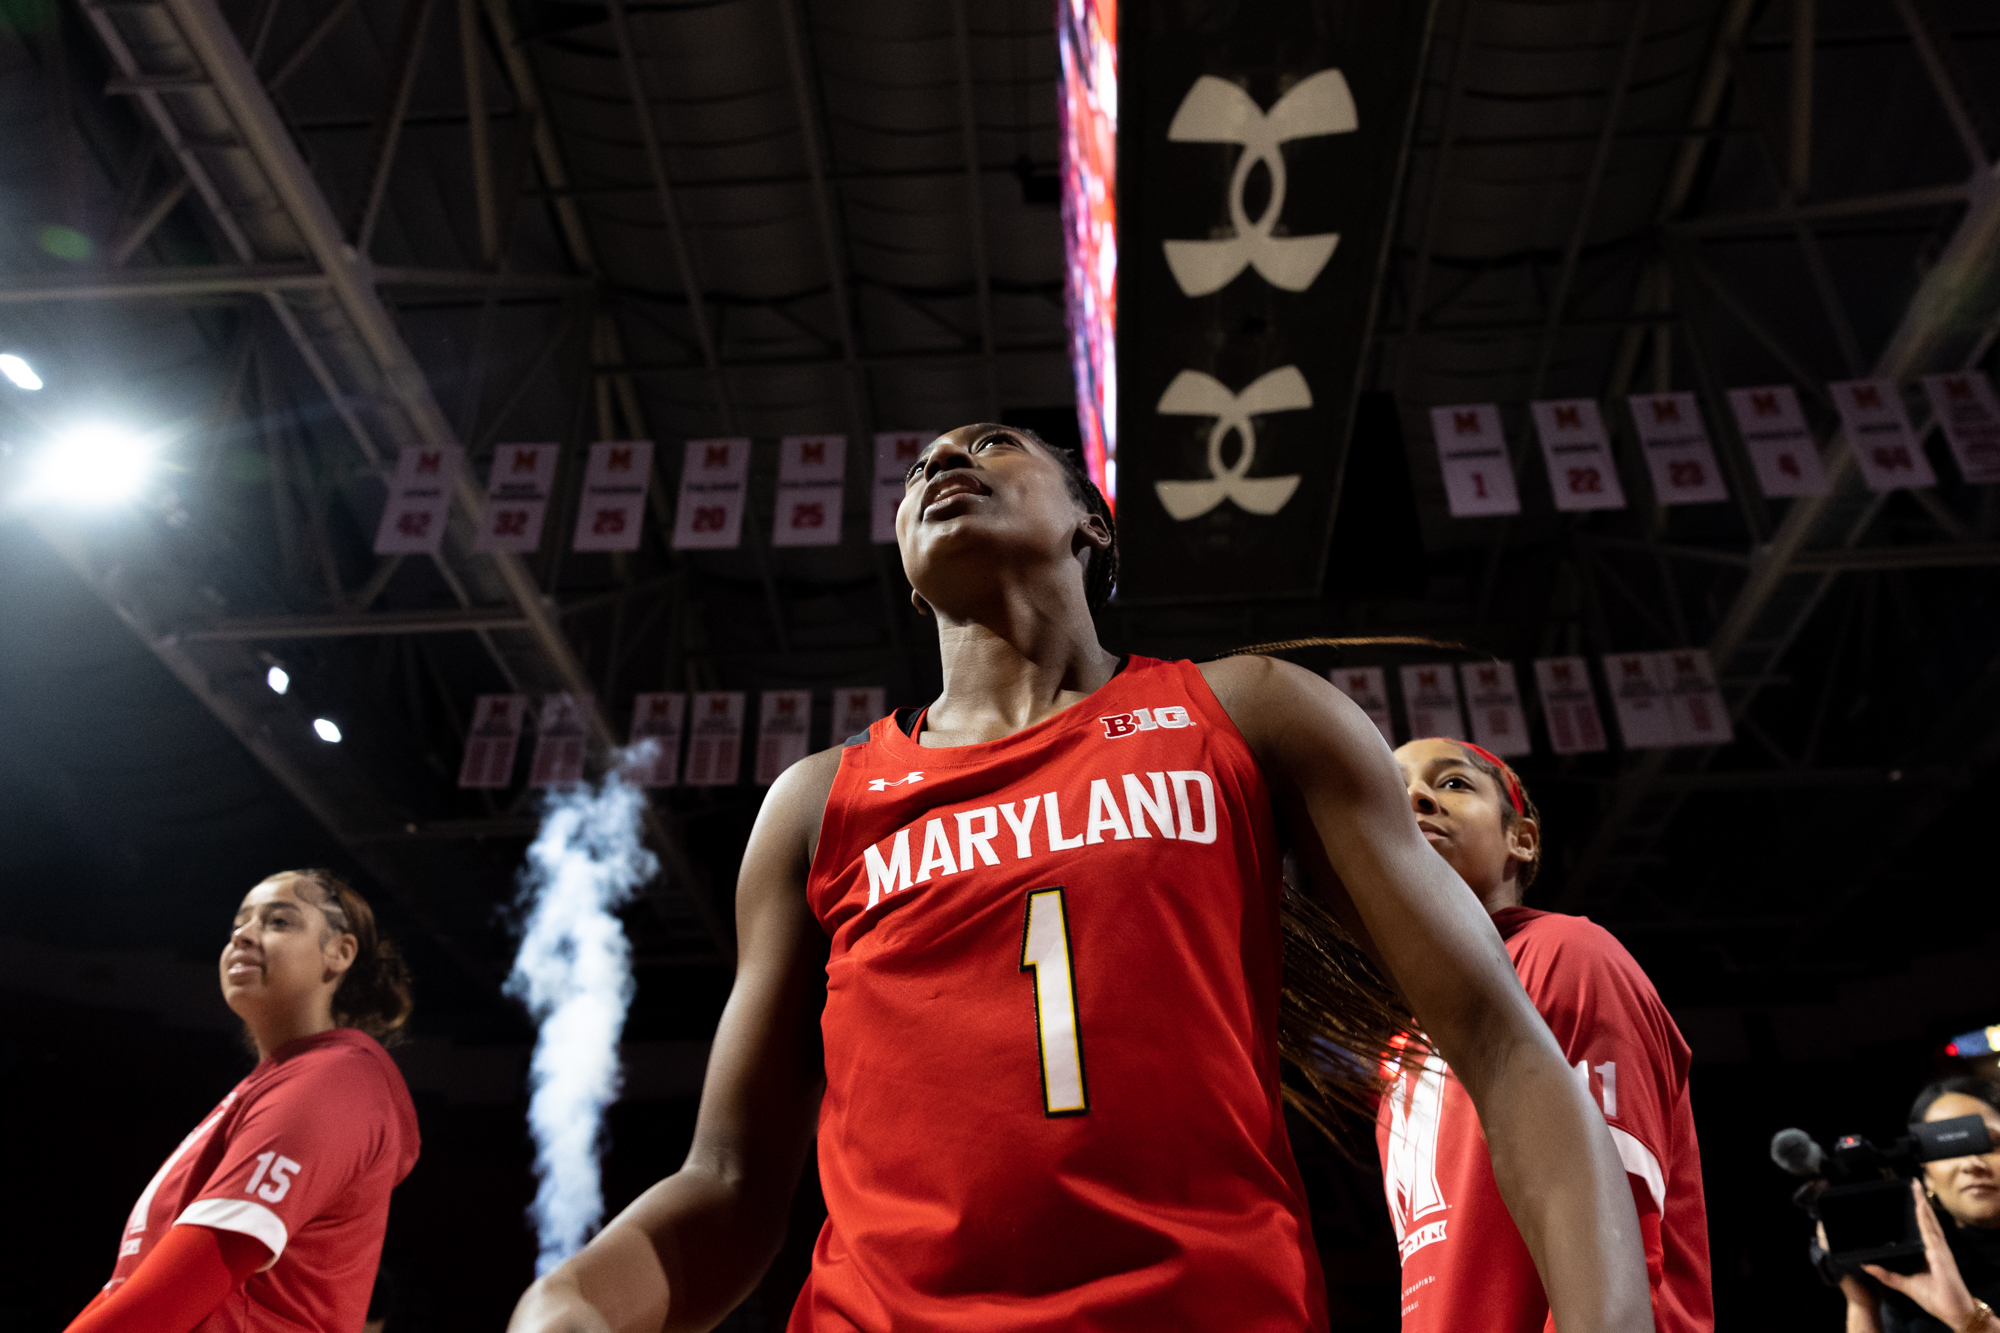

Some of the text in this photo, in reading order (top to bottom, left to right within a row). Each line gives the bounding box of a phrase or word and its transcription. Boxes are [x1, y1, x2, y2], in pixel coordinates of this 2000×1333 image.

[513, 450, 537, 473] M
[608, 449, 631, 471] M
[704, 445, 729, 467] M
[801, 442, 825, 464] M
[1471, 472, 1487, 498] 1
[1567, 466, 1601, 493] 22
[593, 508, 627, 534] 25
[692, 506, 727, 532] 20
[792, 502, 825, 529] 25
[863, 770, 1218, 911] MARYLAND
[1019, 885, 1091, 1118] 1
[244, 1150, 302, 1204] 15
